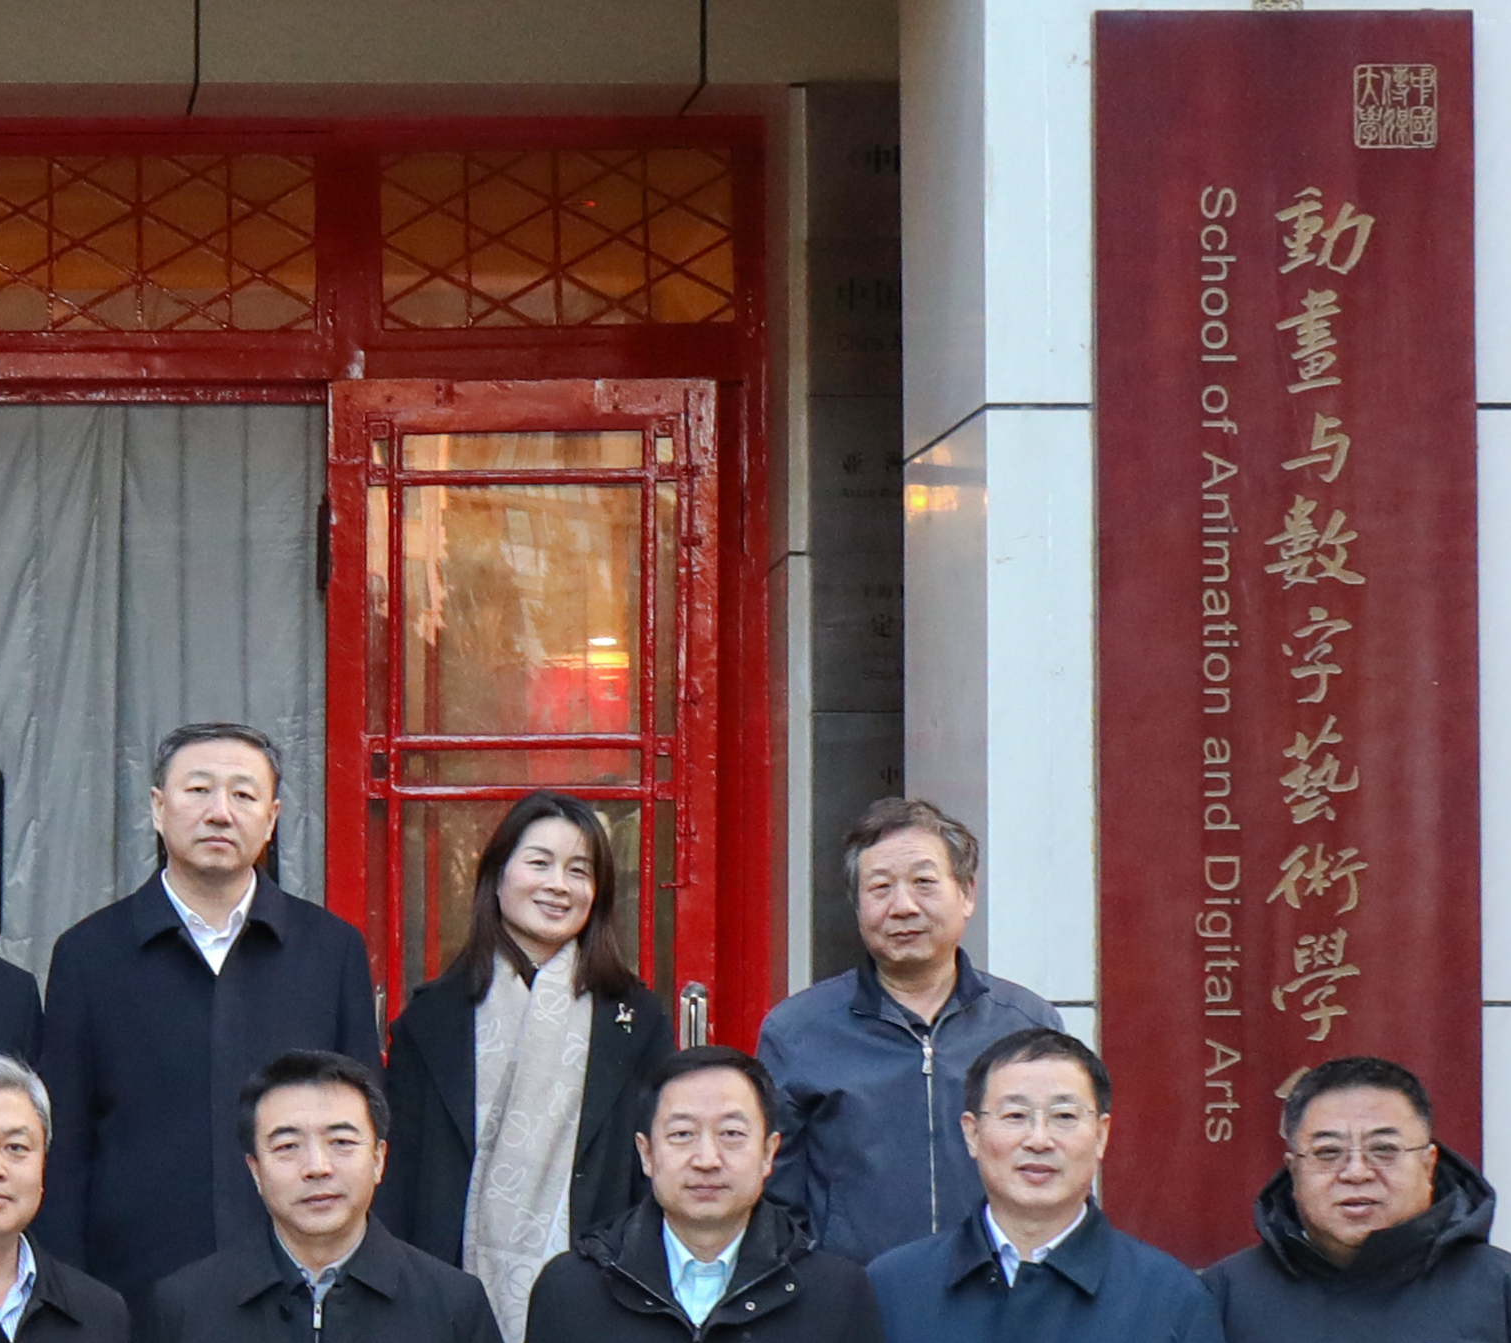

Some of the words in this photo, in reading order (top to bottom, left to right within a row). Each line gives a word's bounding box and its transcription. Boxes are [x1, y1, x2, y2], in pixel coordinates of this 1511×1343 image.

[1200, 184, 1239, 363] School
[1201, 384, 1239, 435] of
[1201, 451, 1240, 714] Animation
[1263, 186, 1376, 1140] 動畫与數字藝術學
[1203, 736, 1241, 831] and
[1195, 857, 1241, 1018] Digital
[1204, 1040, 1242, 1143] Arts
